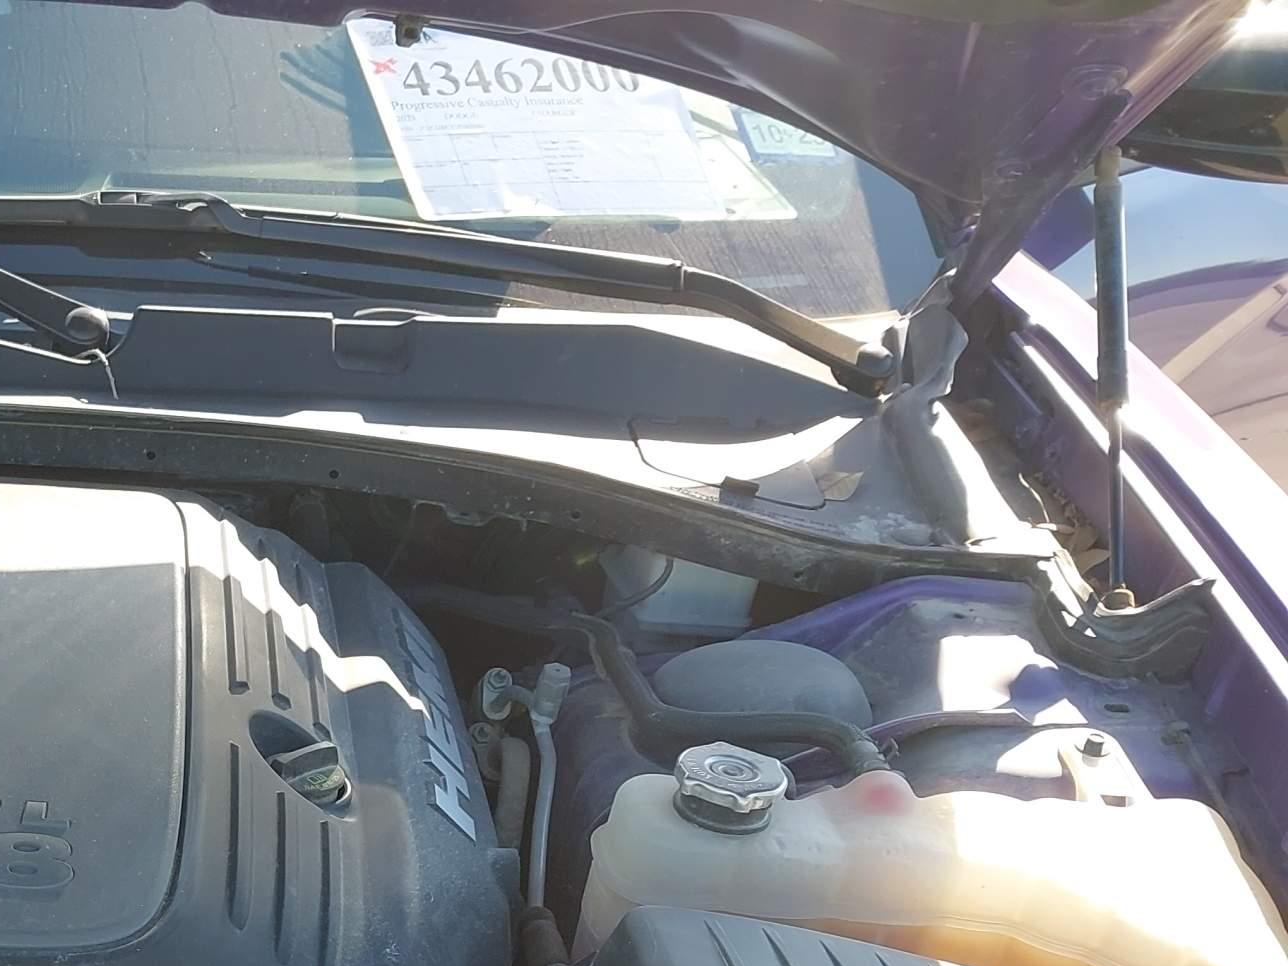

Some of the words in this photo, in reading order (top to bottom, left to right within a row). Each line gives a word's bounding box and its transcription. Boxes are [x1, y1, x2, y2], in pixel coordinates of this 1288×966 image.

[402, 56, 639, 97] 43462000
[391, 101, 465, 113] Progressive
[467, 97, 520, 110] Casualty
[524, 95, 584, 107] Insurance
